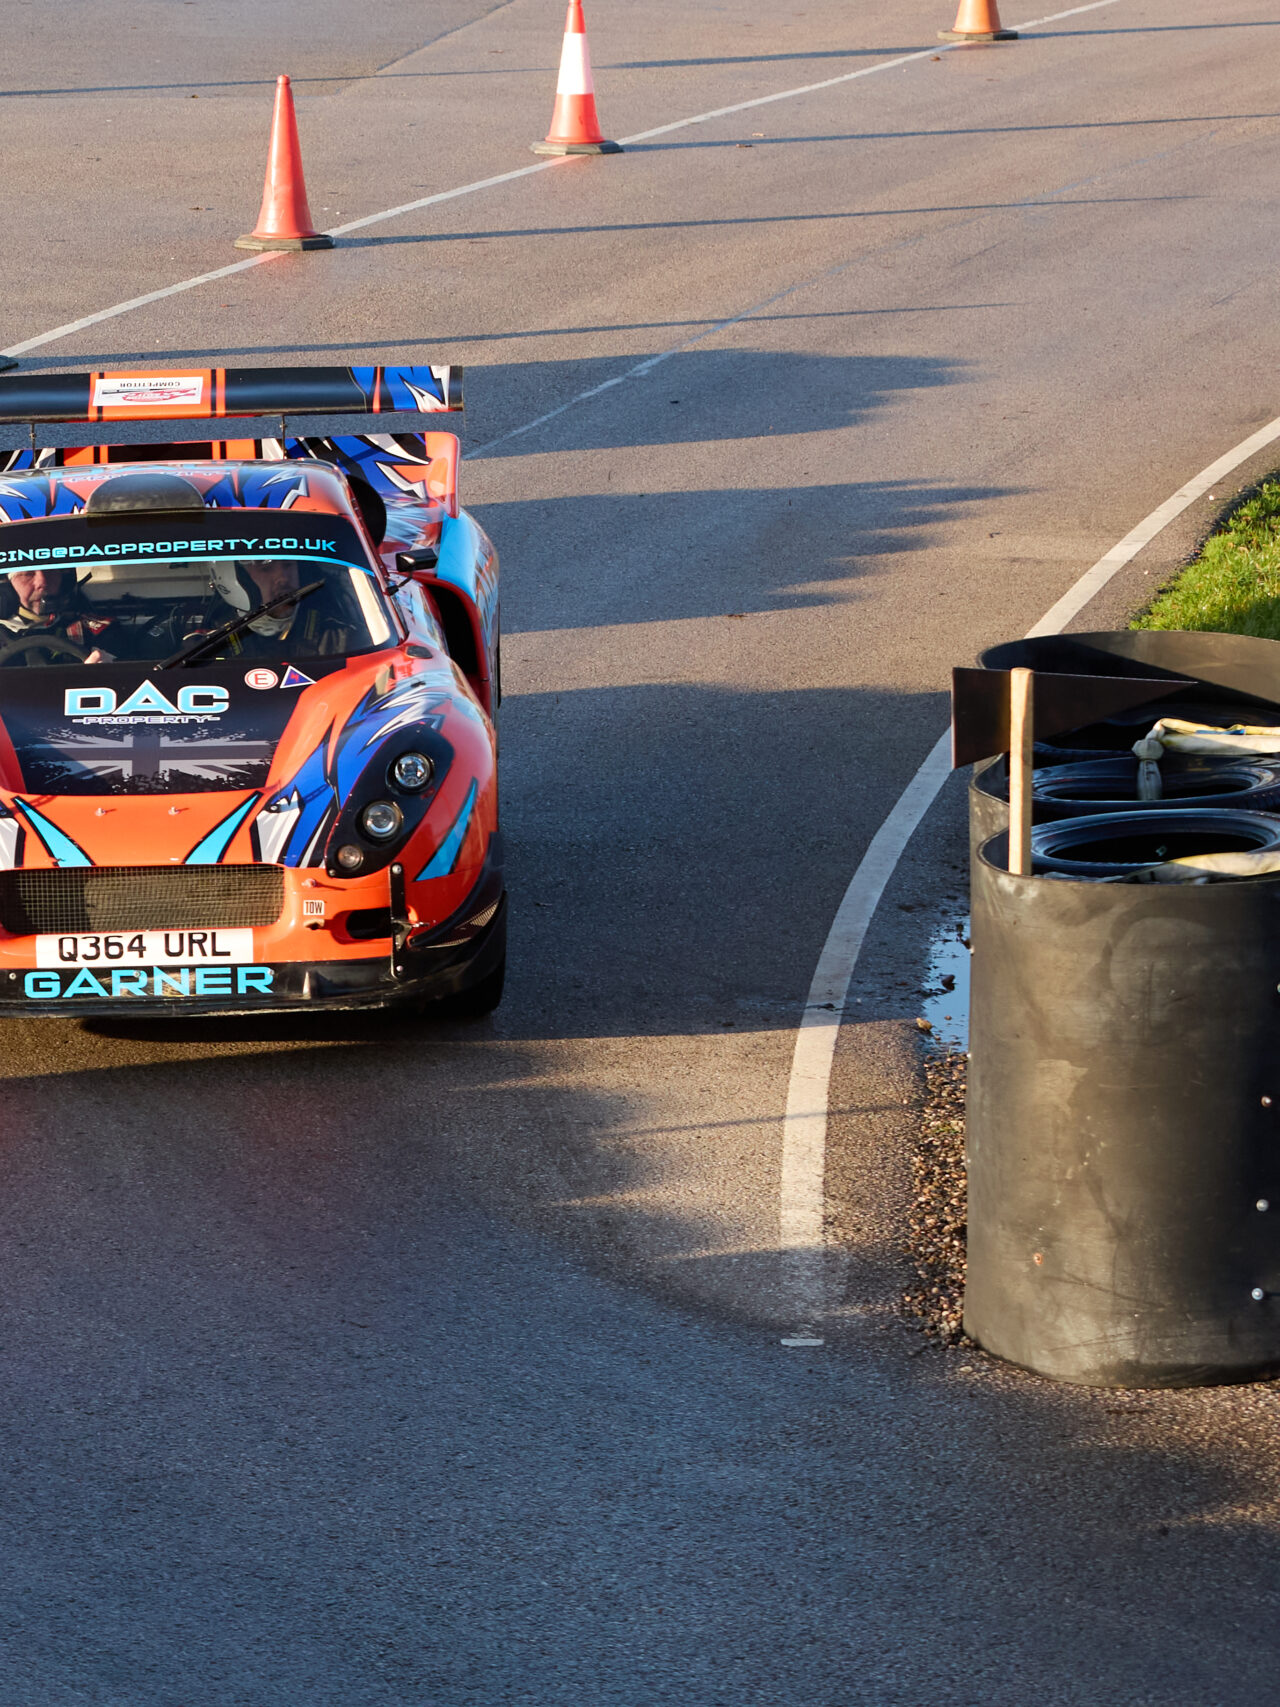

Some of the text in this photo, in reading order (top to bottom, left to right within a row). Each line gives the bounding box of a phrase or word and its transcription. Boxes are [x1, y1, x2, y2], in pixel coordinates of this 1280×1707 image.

[254, 674, 268, 685] E
[64, 679, 229, 716] DAC
[83, 715, 208, 725] PROPERTY
[305, 901, 323, 914] TOW
[58, 931, 231, 962] Q364 URL
[24, 966, 274, 999] GARNER
